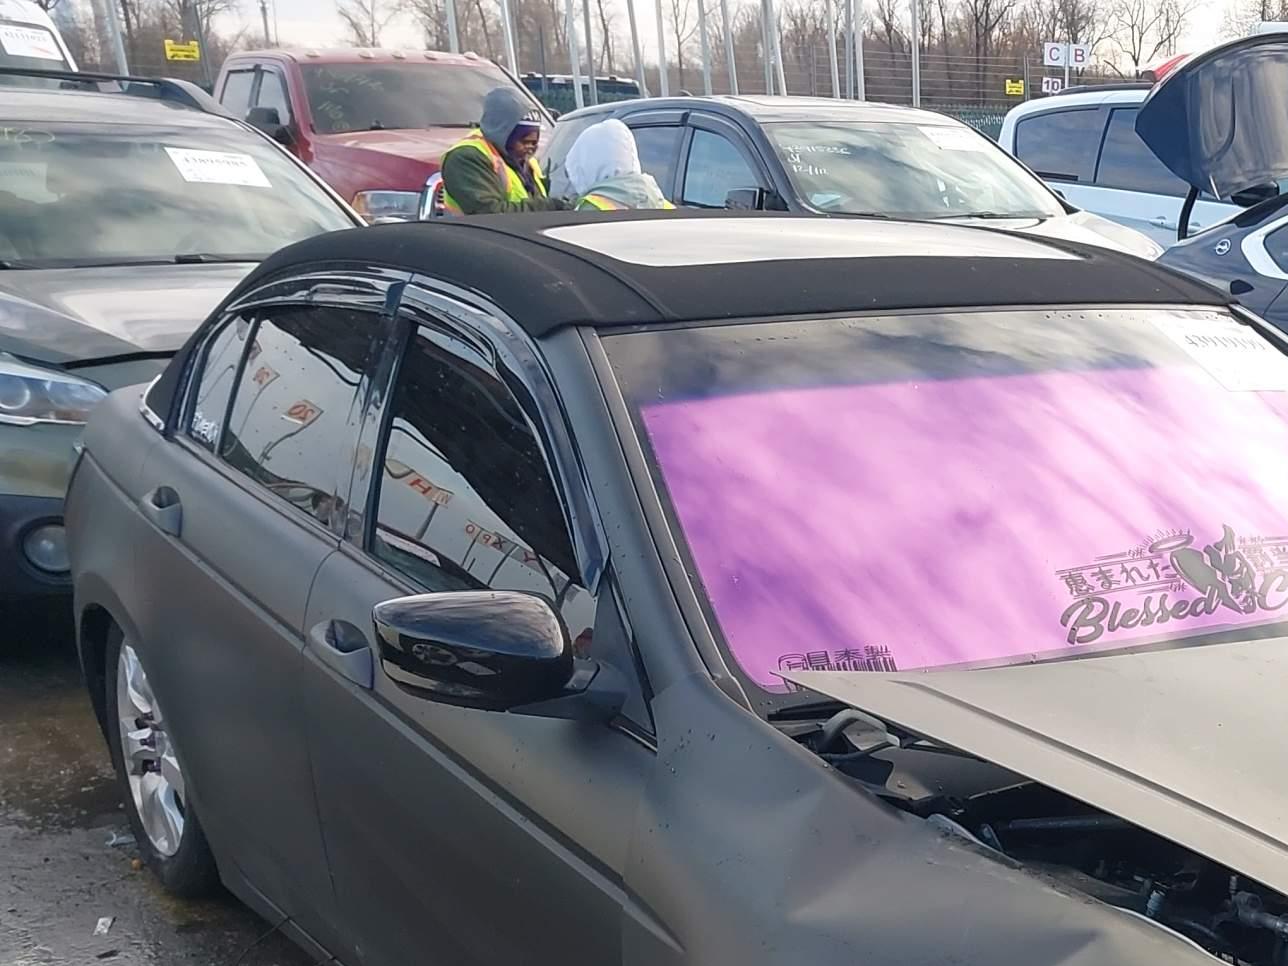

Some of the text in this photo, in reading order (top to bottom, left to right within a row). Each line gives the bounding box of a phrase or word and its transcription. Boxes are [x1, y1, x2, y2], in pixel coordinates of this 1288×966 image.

[1049, 46, 1060, 61] C
[1074, 48, 1085, 62] B
[1044, 79, 1060, 91] 10
[1060, 587, 1220, 645] Blessed
